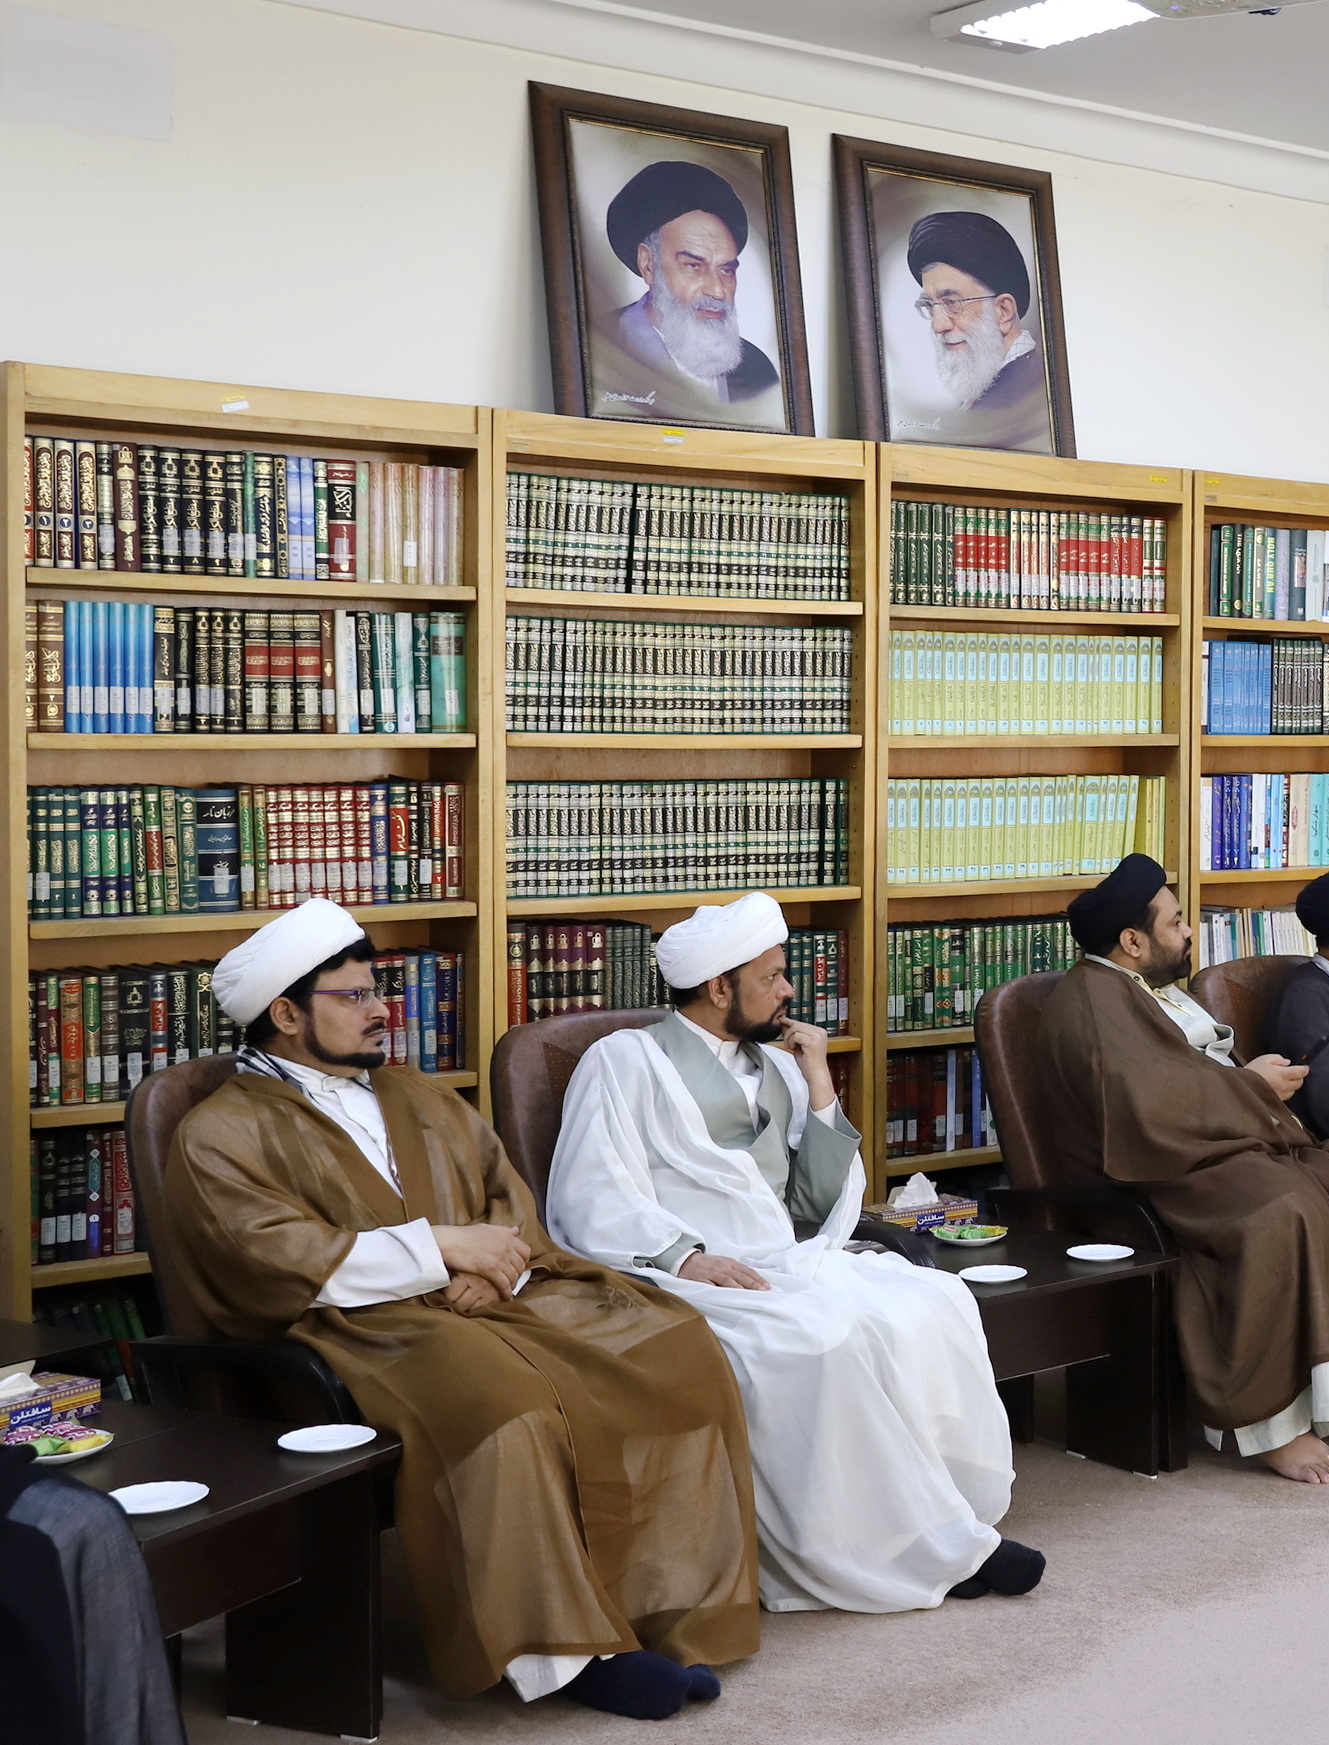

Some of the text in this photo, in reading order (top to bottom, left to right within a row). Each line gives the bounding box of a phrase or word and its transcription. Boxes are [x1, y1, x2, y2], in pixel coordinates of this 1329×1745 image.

[1267, 537, 1275, 559] HOLY
[917, 1214, 945, 1226] سافتلن
[10, 1405, 52, 1424] سافتلن
